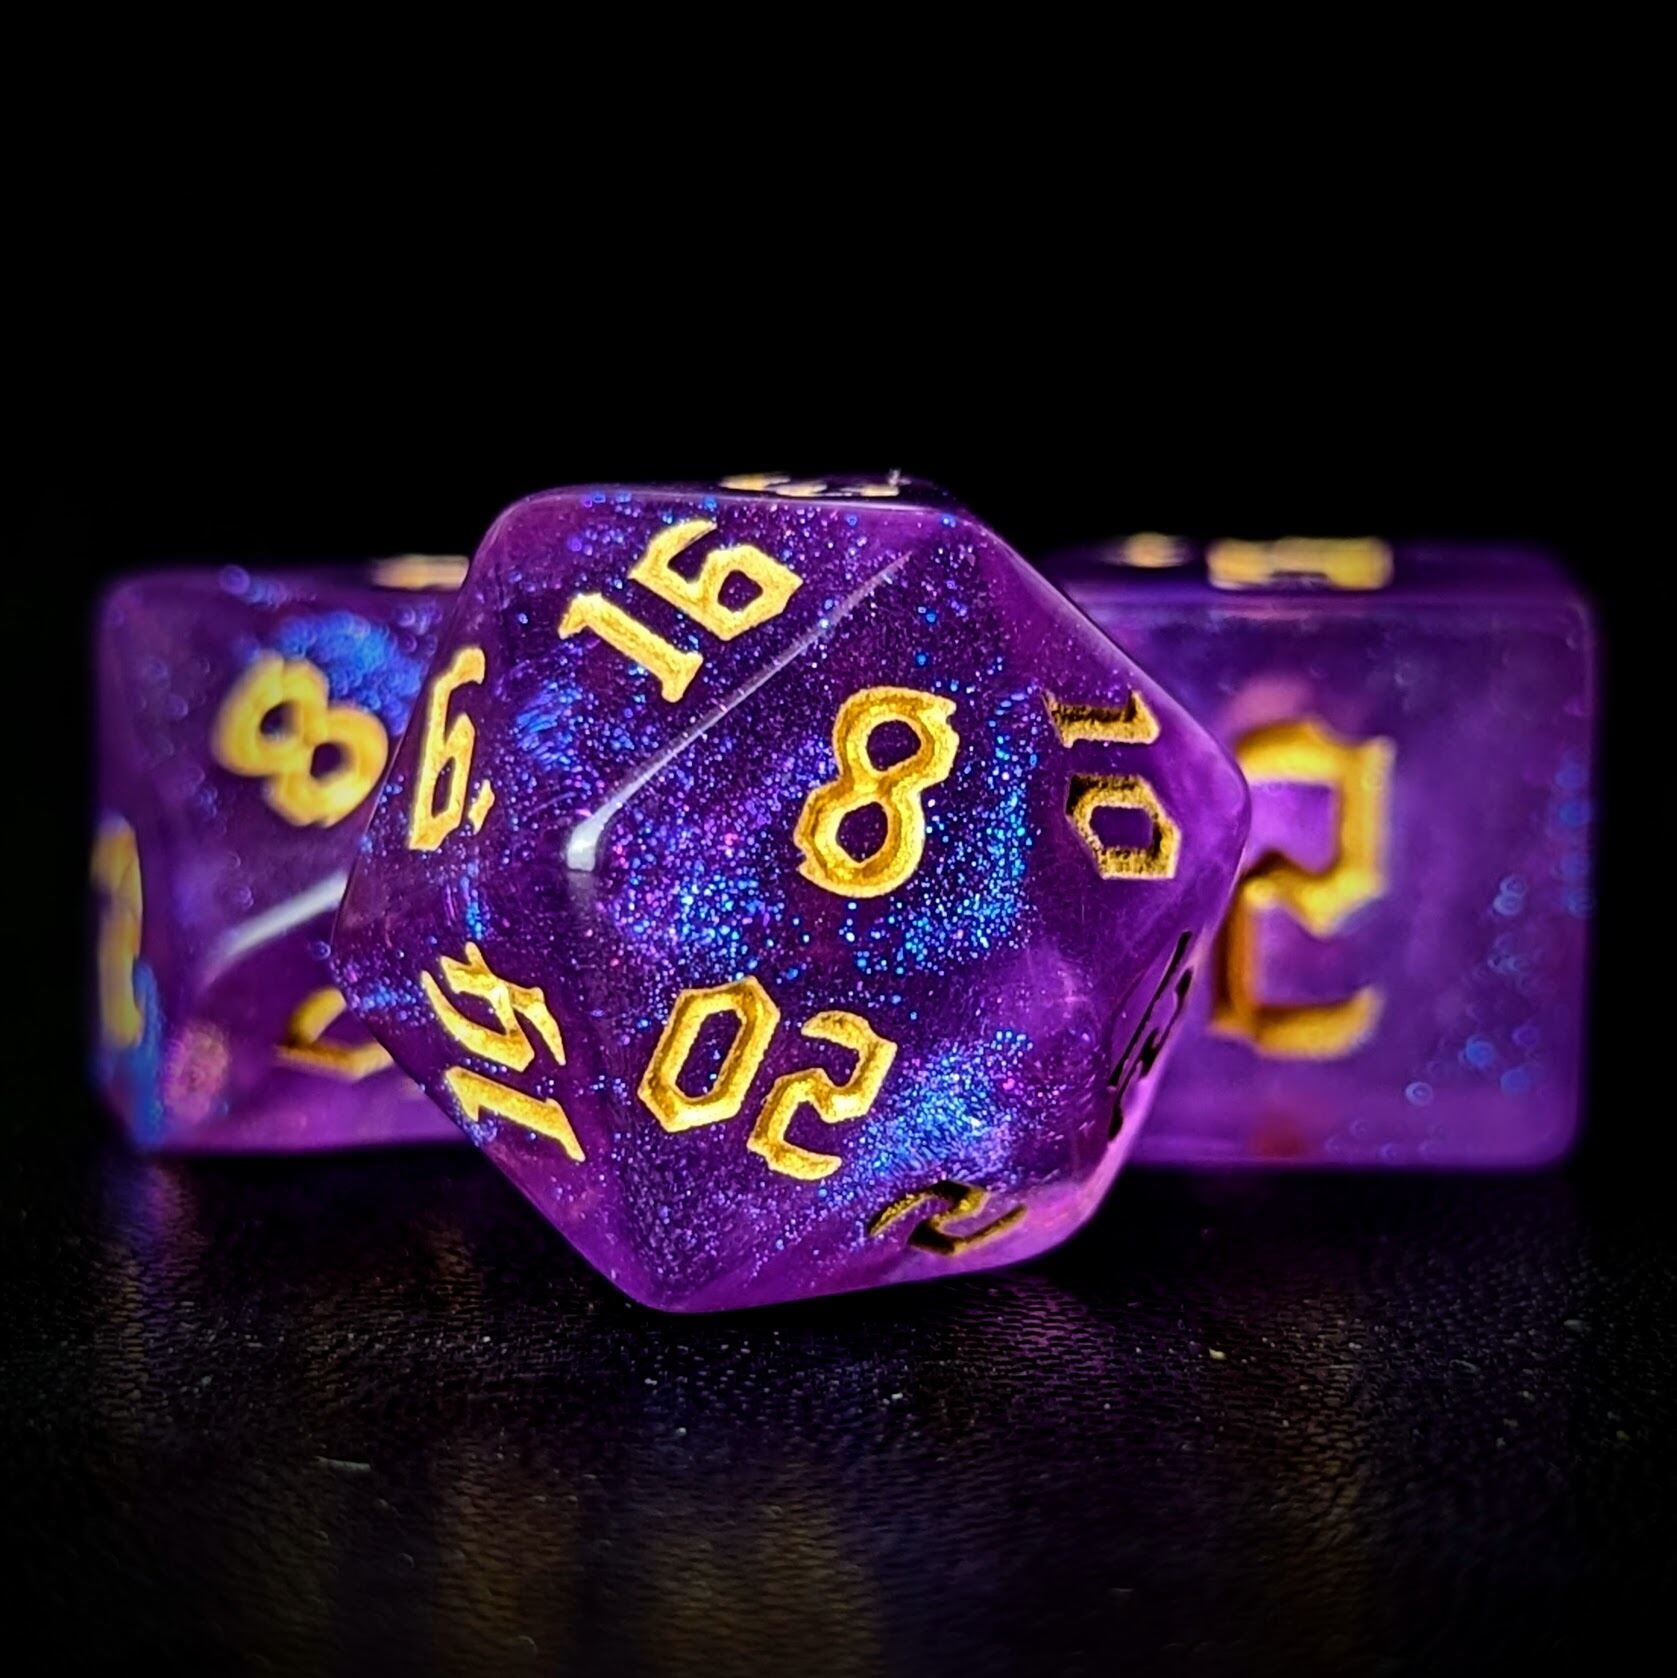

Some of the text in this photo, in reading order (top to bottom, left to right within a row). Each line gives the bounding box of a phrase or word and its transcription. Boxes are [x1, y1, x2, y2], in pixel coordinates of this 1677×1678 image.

[559, 519, 803, 703] 16
[214, 650, 388, 827] 8
[793, 686, 959, 898] 8
[1042, 690, 1181, 880] 10
